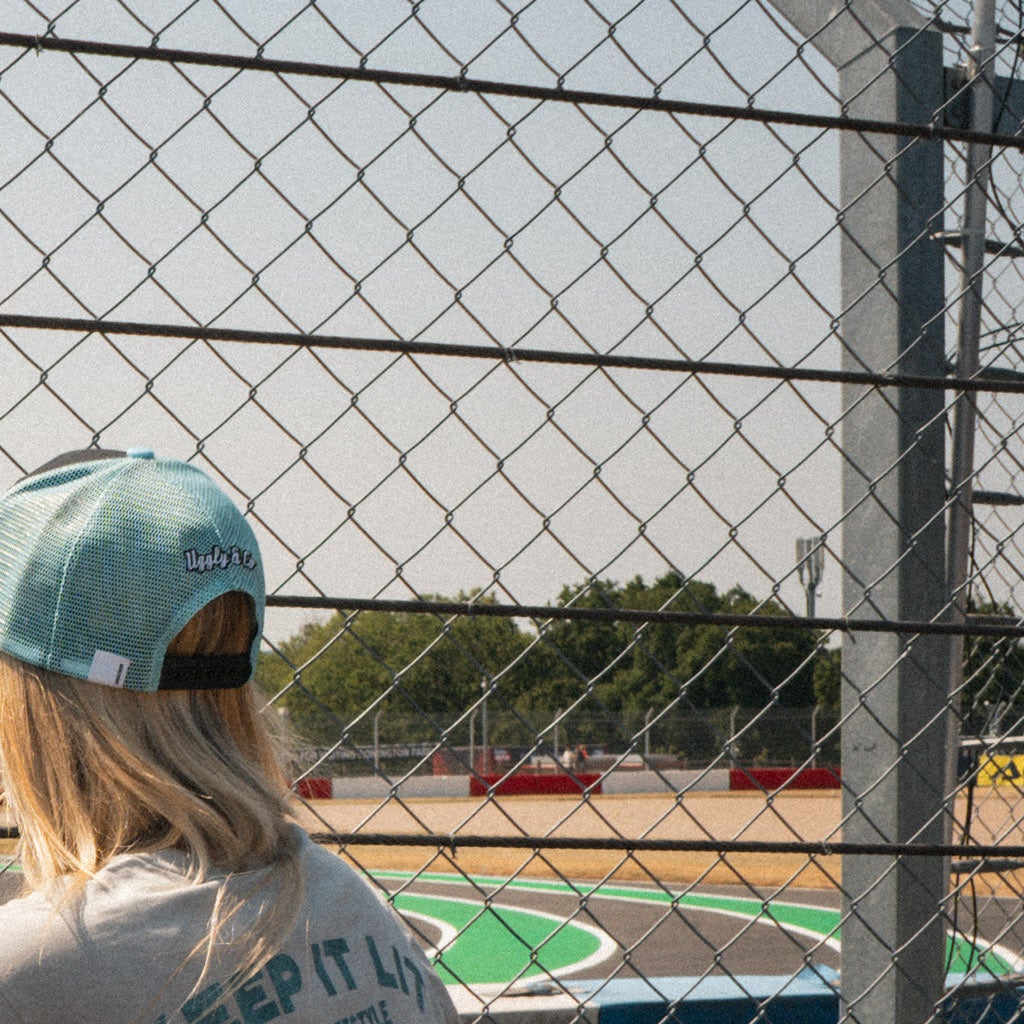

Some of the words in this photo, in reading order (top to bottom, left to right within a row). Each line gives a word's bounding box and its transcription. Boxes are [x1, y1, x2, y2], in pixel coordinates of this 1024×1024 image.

[184, 545, 229, 573] Uggly
[311, 938, 357, 996] IT
[365, 935, 425, 1012] LIT
